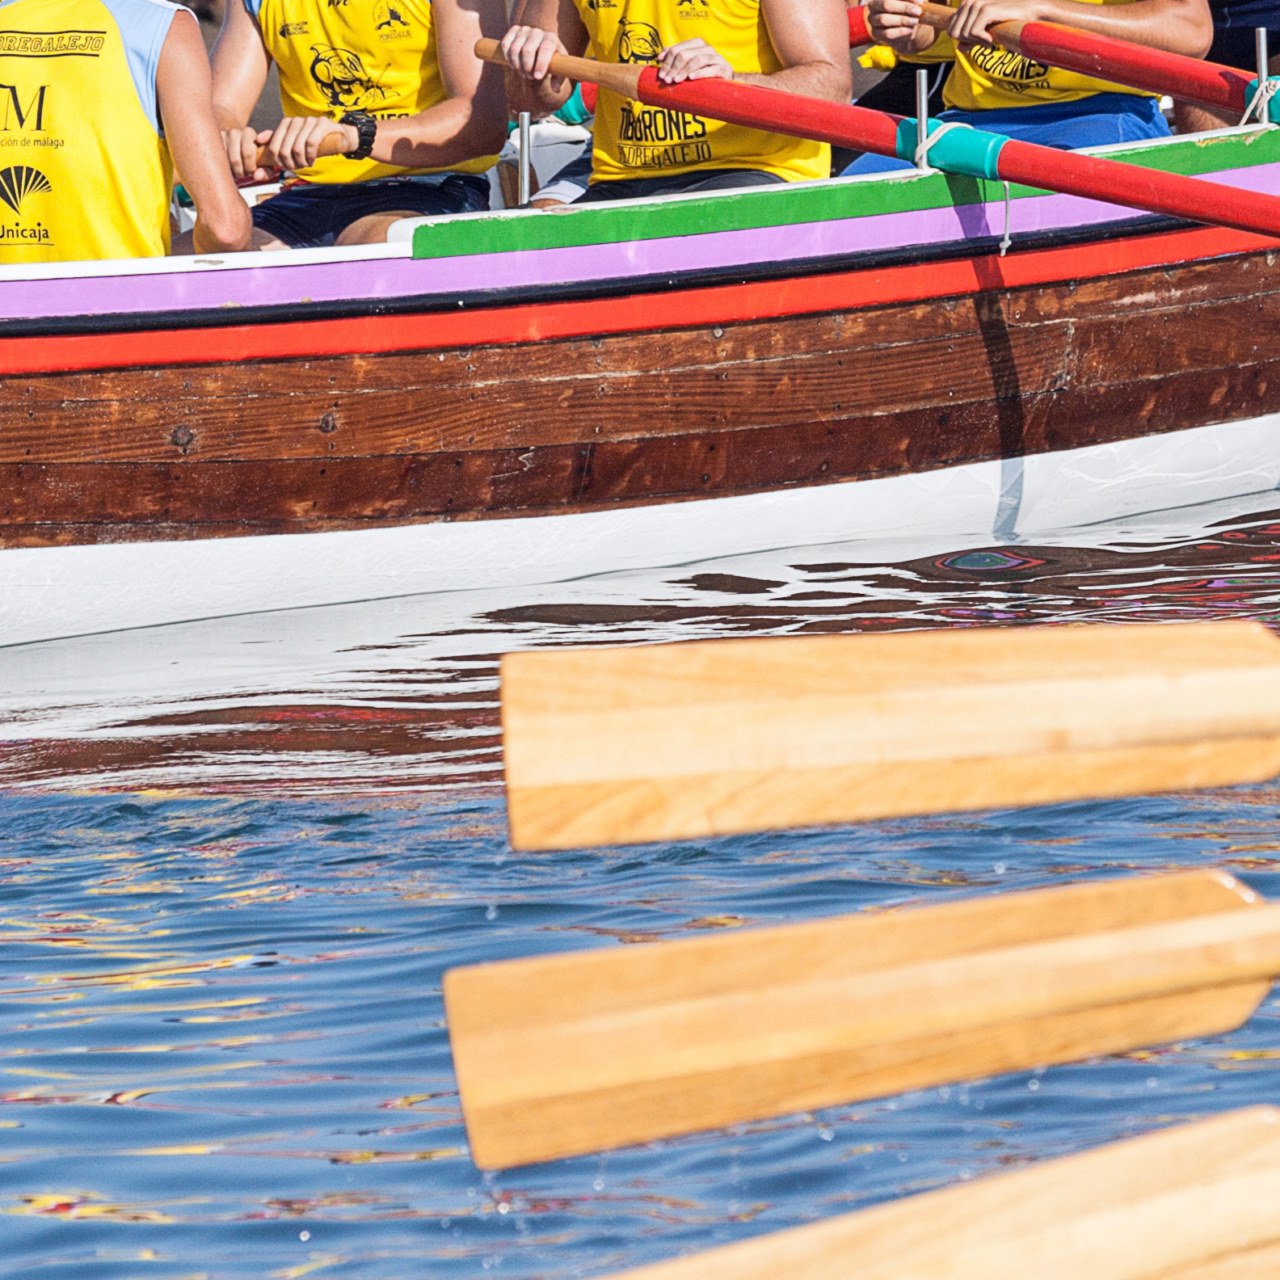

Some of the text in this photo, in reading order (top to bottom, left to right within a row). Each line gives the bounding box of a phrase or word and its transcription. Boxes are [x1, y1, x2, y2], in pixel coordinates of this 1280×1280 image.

[20, 136, 31, 147] de
[33, 135, 65, 149] málaga
[619, 143, 712, 168] DREGALEJO
